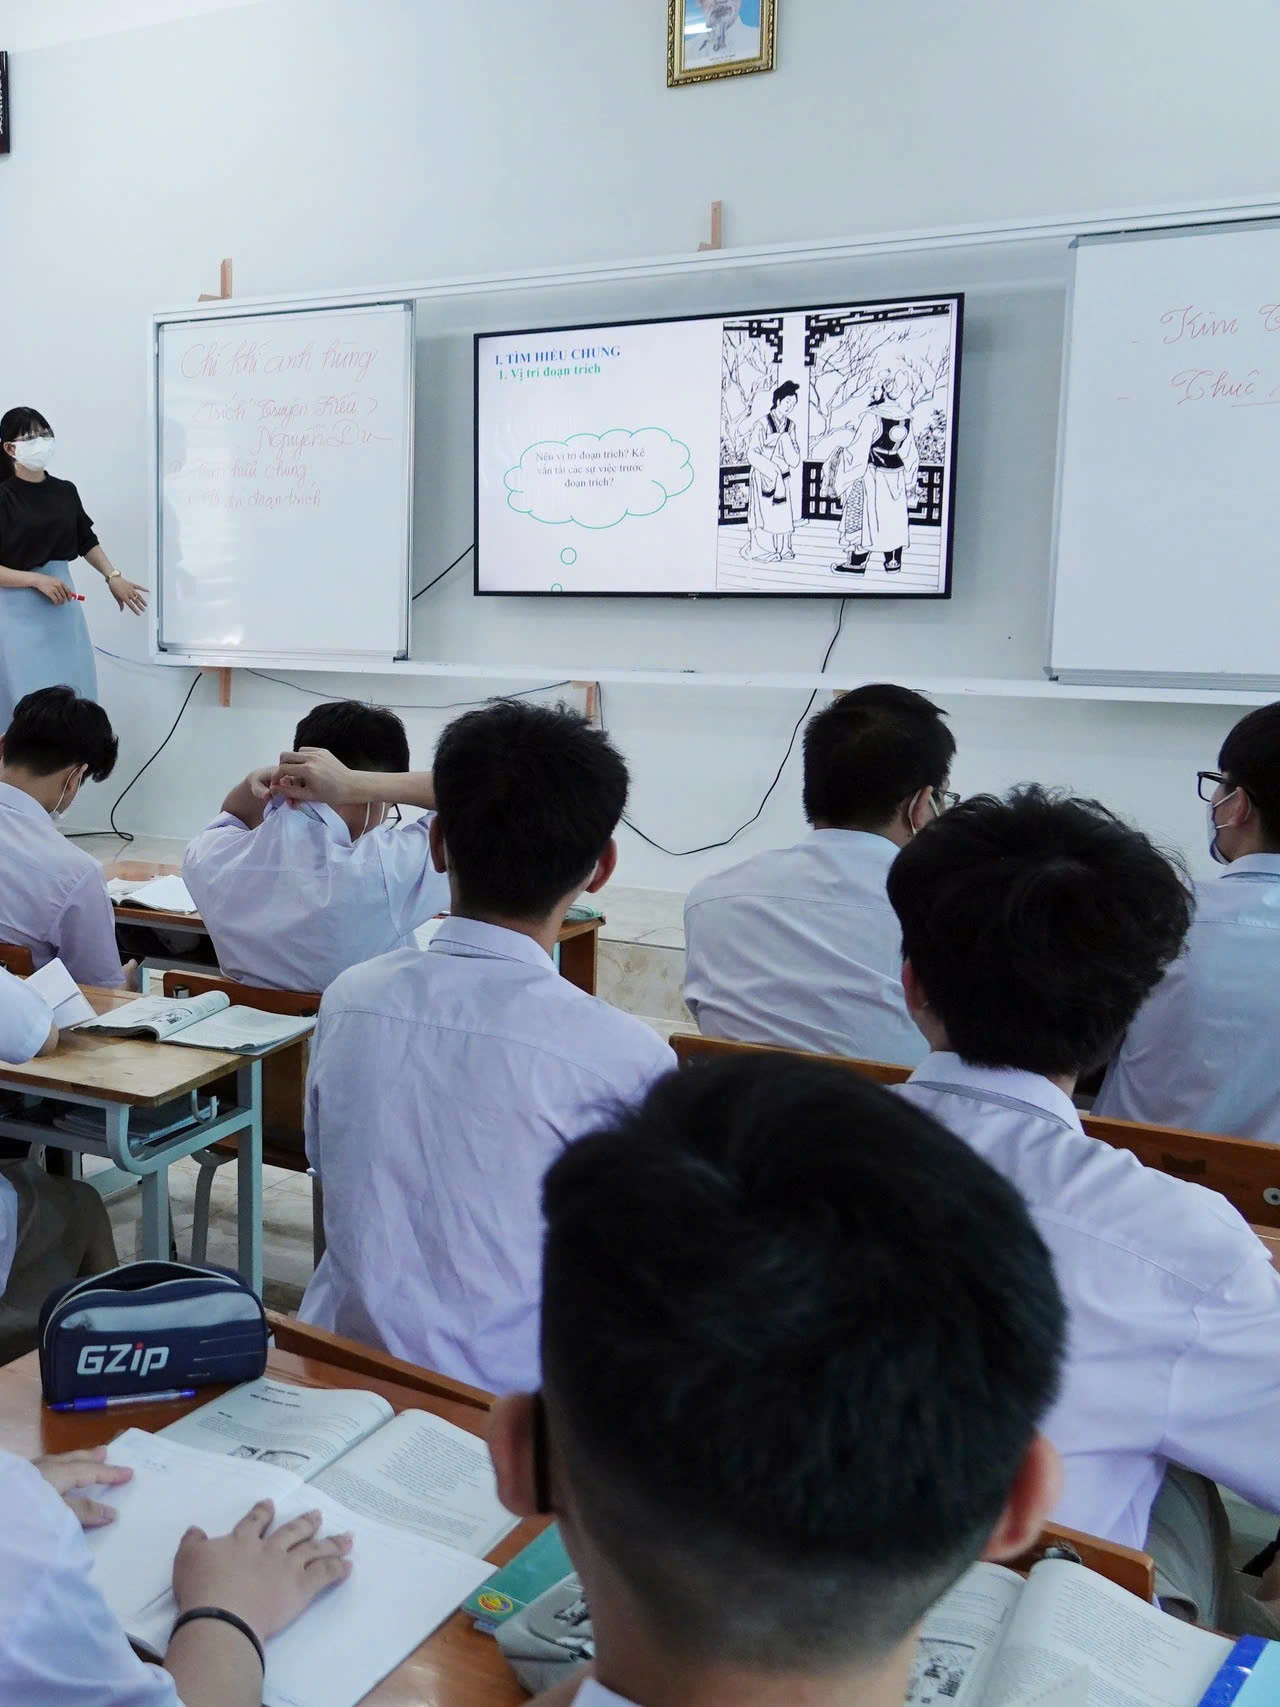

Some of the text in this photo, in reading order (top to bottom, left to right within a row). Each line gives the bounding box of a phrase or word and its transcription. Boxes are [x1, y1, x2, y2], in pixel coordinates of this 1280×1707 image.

[1160, 304, 1239, 345] Kim
[571, 345, 620, 360] CHUNG
[510, 368, 523, 381] Vị
[526, 367, 540, 378] trí
[543, 366, 570, 379] đoạn
[580, 450, 601, 461] đoạn
[564, 478, 586, 489] đoạn
